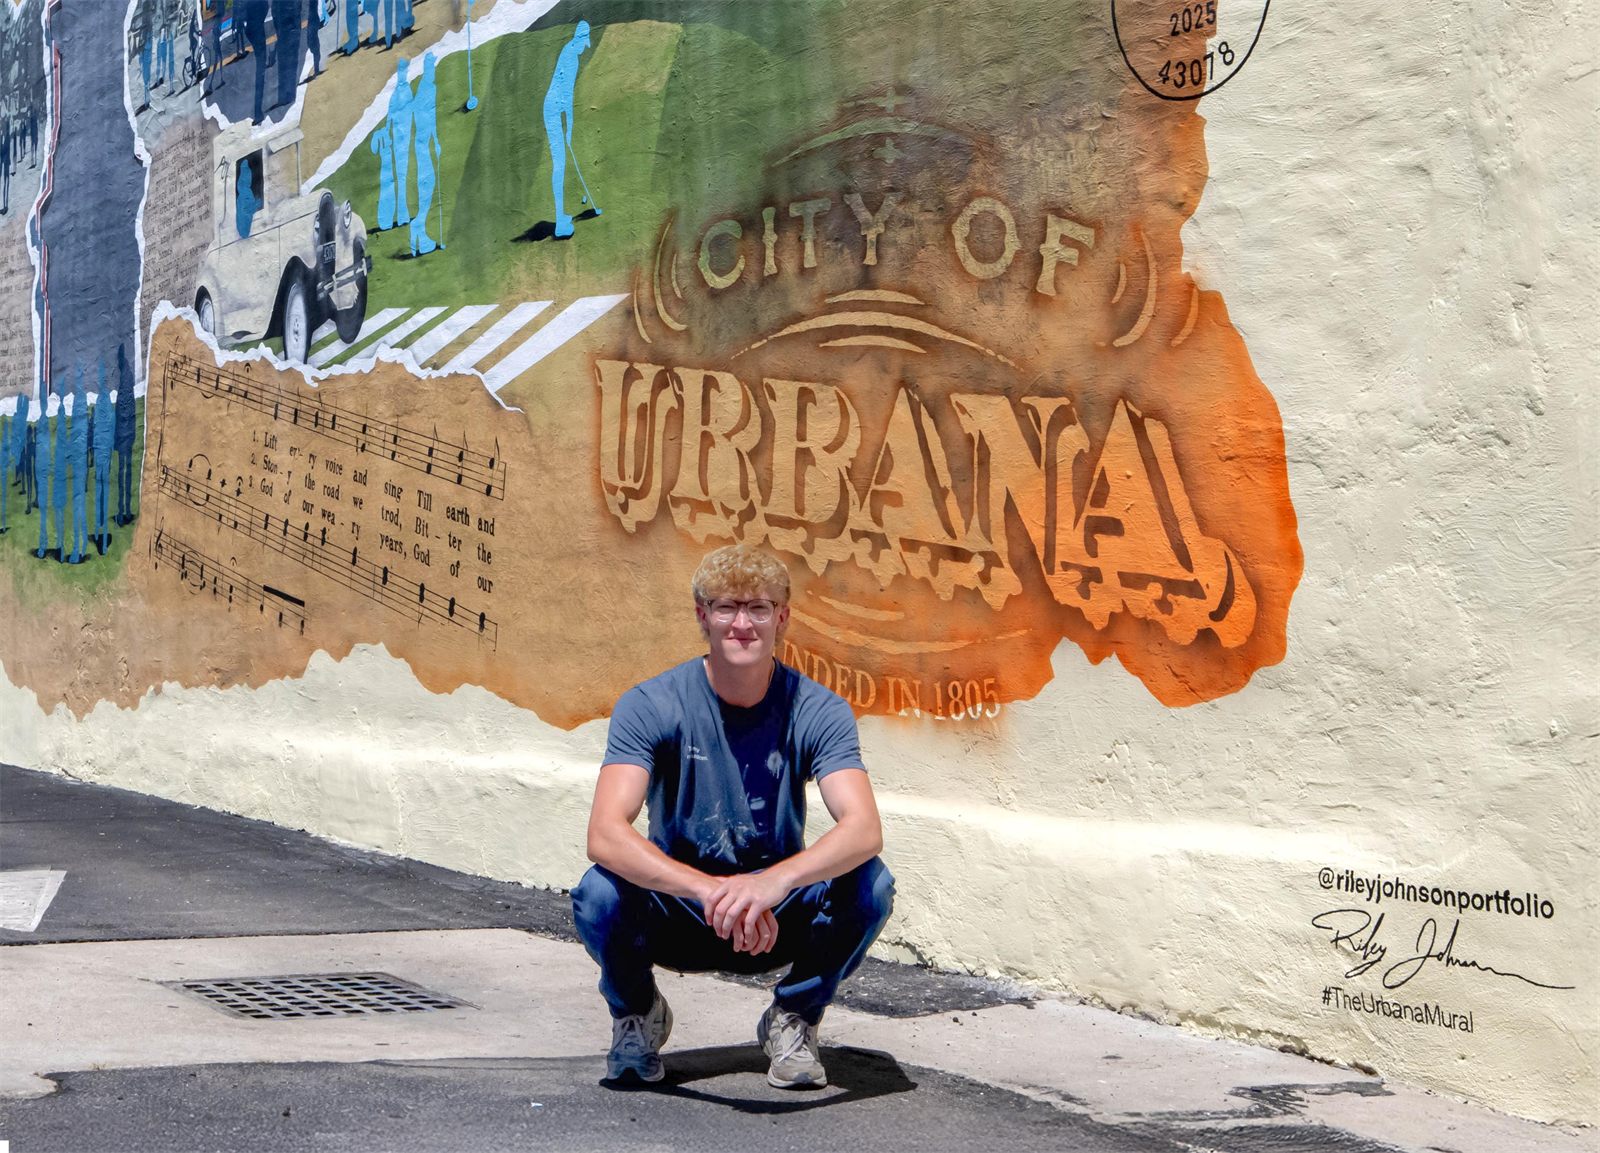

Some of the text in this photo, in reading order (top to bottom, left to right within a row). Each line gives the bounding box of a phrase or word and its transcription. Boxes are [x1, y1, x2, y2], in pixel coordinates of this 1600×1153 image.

[1169, 1, 1217, 37] 2025
[1158, 41, 1235, 89] 43078
[698, 193, 1096, 297] CITY OF
[264, 431, 278, 452] Lift
[308, 453, 318, 470] ry
[325, 458, 343, 476] voice
[353, 469, 368, 487] and
[383, 479, 404, 503] sing
[417, 489, 432, 512] Till
[446, 505, 470, 527] earth
[477, 517, 495, 537] and
[304, 473, 316, 491] the
[322, 484, 340, 501] road
[353, 496, 364, 510] we
[381, 505, 402, 532] trod,
[415, 516, 429, 538] Bit
[448, 531, 462, 552] ter
[477, 542, 492, 565] the
[594, 358, 1257, 649] URBANA
[260, 478, 274, 498] God
[283, 489, 292, 505] of
[302, 499, 315, 515] our
[379, 532, 407, 560] years,
[413, 543, 431, 567] God
[450, 560, 461, 578] of
[477, 575, 494, 594] our
[885, 676, 922, 719] IN
[933, 677, 1001, 721] 1805
[1318, 867, 1555, 919] @rileyjohnsonportfolio
[1322, 985, 1474, 1034] #TheUrbanaMural
